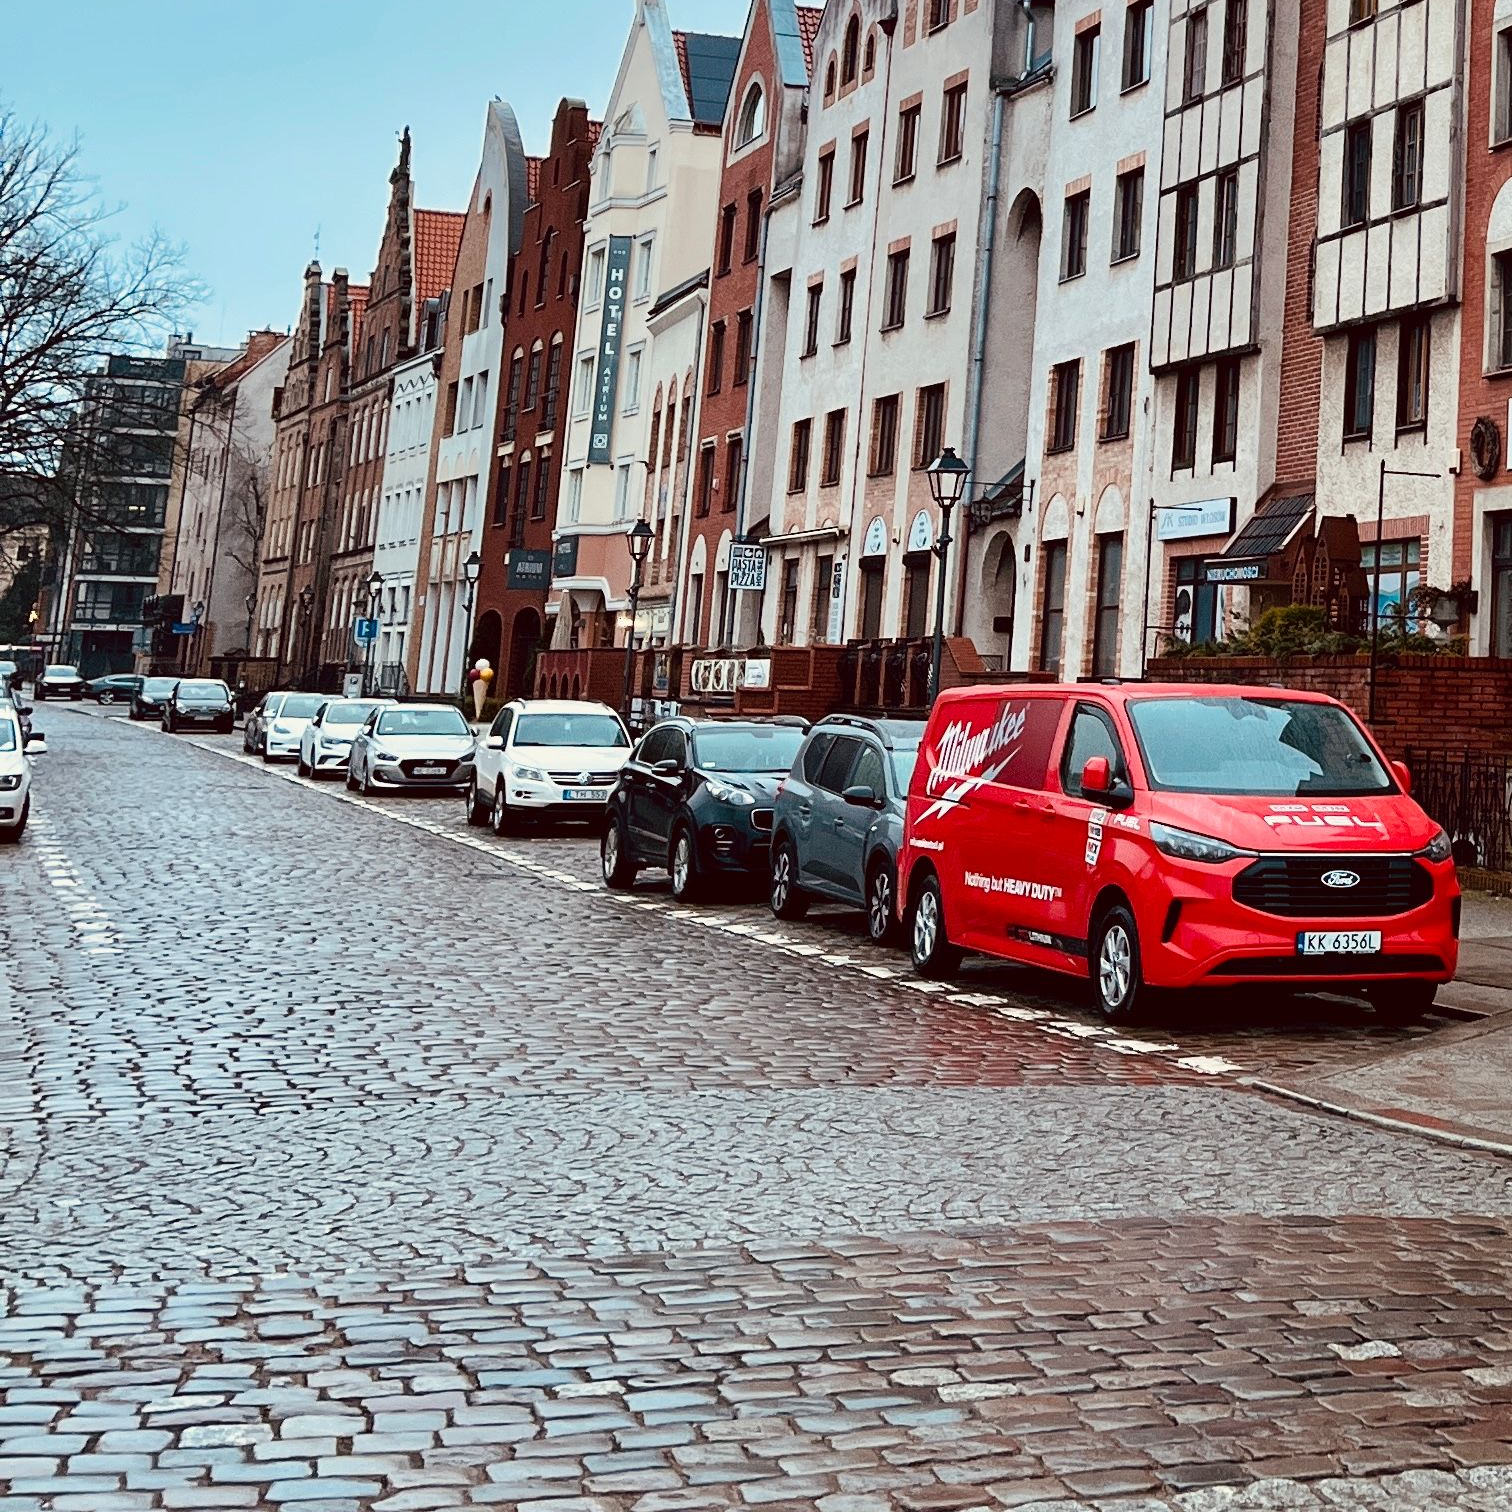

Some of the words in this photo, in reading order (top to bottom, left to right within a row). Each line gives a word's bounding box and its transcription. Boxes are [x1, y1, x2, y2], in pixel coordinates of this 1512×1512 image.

[605, 268, 624, 355] HOTEL
[598, 367, 611, 421] ATRIUM
[732, 558, 756, 573] PASTA
[730, 572, 755, 587] PIZZA
[926, 701, 1027, 795] Milwaukee
[1113, 813, 1140, 830] FUEL
[1263, 814, 1383, 827] FUEL
[964, 871, 991, 893] Nothing
[991, 875, 1003, 891] but
[1003, 878, 1031, 897] HEAVY
[1326, 871, 1355, 886] Ford
[1307, 934, 1326, 950] KK
[1333, 934, 1376, 950] 6356L
